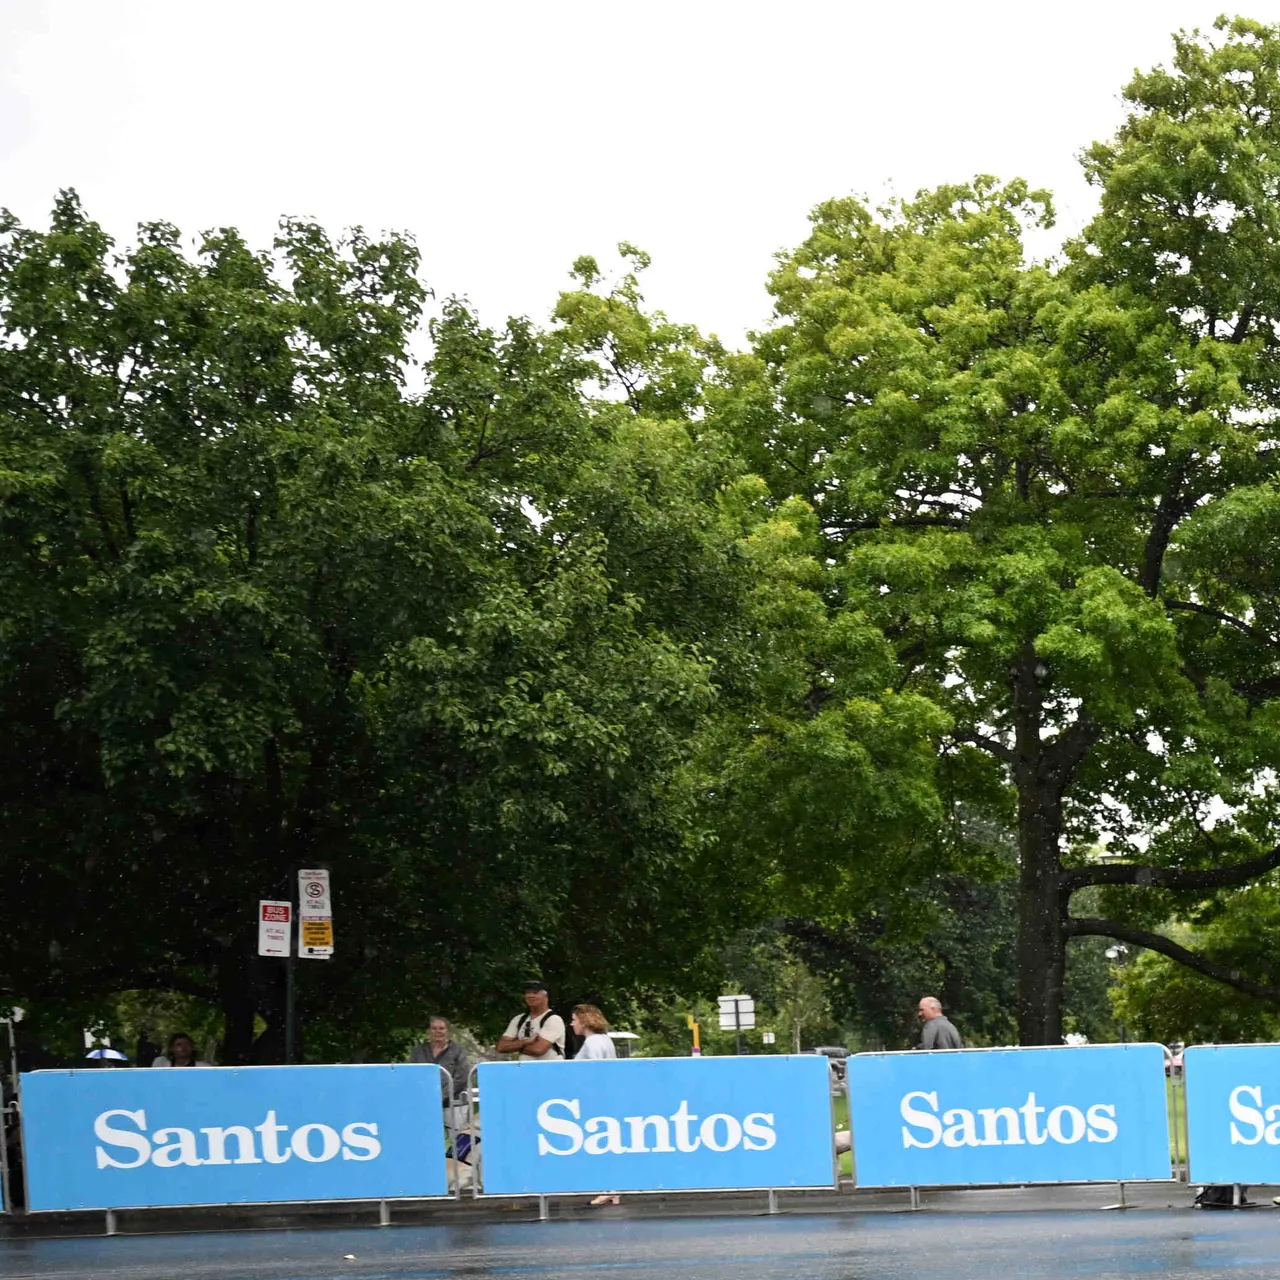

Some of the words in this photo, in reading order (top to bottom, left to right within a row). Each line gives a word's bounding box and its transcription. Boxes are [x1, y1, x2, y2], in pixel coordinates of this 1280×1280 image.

[95, 1109, 381, 1169] Santos
[538, 1098, 777, 1156] Santos
[901, 1091, 1118, 1149] Santos
